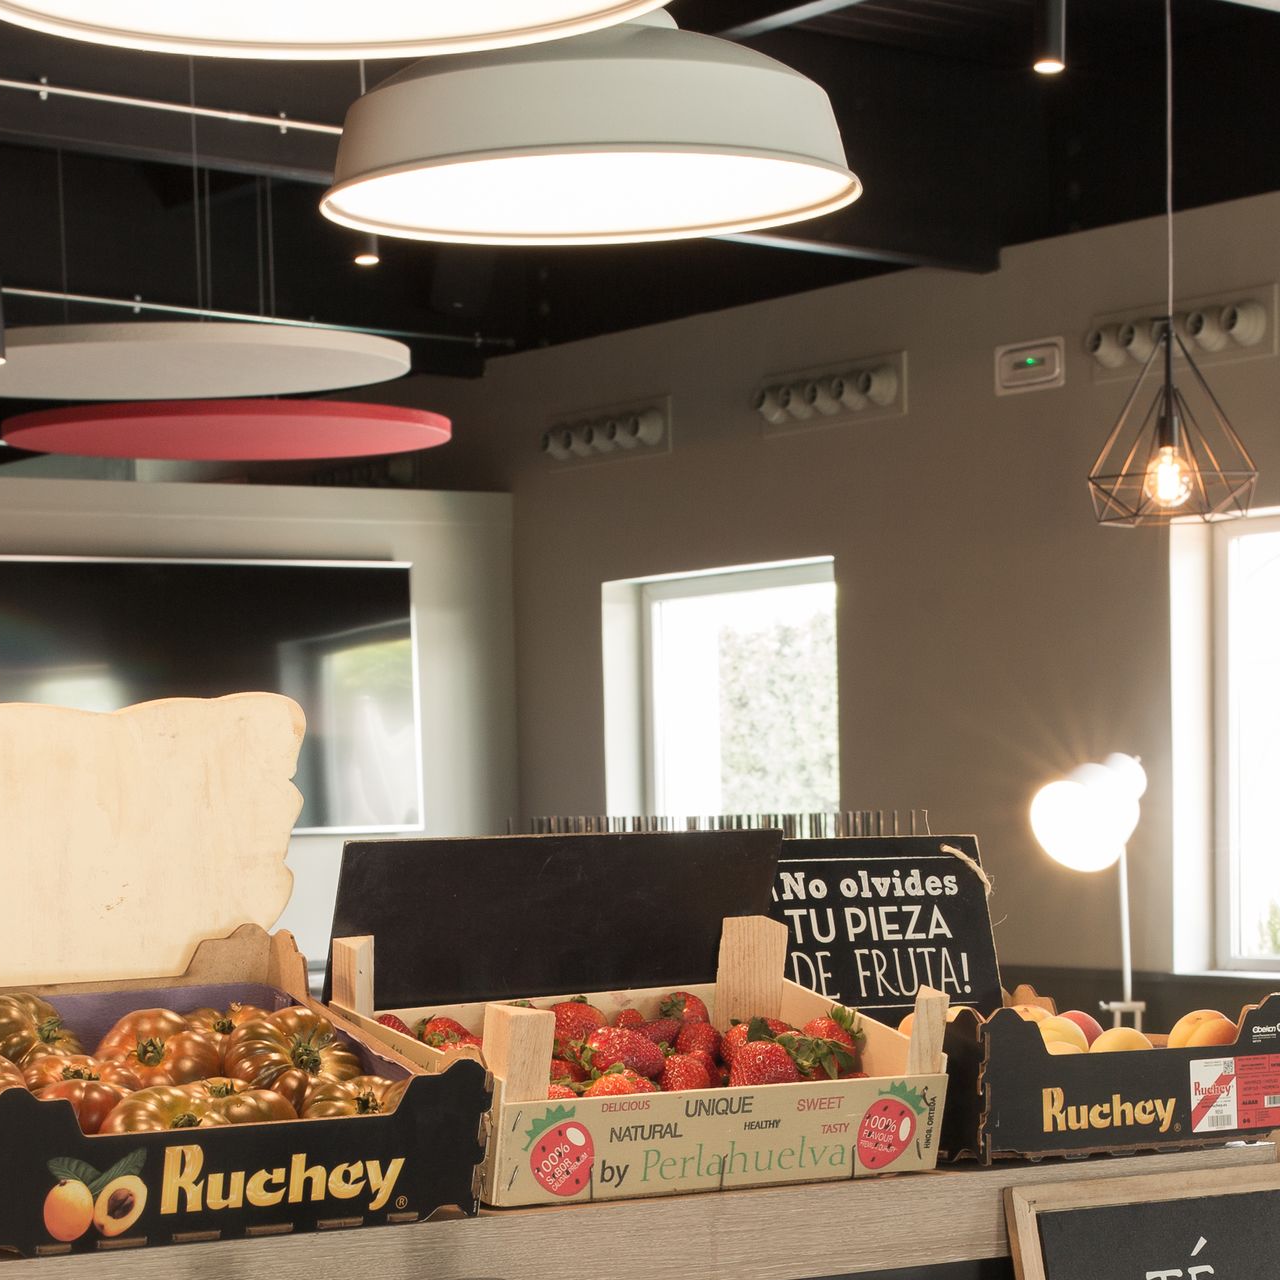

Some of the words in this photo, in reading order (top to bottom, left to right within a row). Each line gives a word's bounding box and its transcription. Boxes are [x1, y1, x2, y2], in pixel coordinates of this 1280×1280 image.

[840, 869, 959, 898] olvides
[784, 908, 836, 944] TU
[844, 904, 953, 942] PIEZA
[791, 951, 840, 999] DE
[854, 947, 971, 997] FRUTA!
[1193, 1081, 1232, 1097] Ruchey
[601, 1100, 651, 1113] DELICIOUS
[685, 1096, 754, 1118] UNIQUE
[796, 1096, 845, 1112] SWEET
[927, 1096, 937, 1126] ORTEGA
[1042, 1086, 1176, 1133] Ruchey
[609, 1123, 683, 1143] NATURAL
[744, 1119, 780, 1131] HEALTHY
[821, 1122, 850, 1134] TASTY
[864, 1114, 897, 1133] 100%
[862, 1129, 893, 1144] FLAVOUR
[534, 1141, 571, 1179] 100%
[545, 1157, 572, 1186] SABOR
[599, 1160, 629, 1188] by
[641, 1135, 846, 1182] Perlahuelva
[160, 1144, 406, 1214] Ruchey
